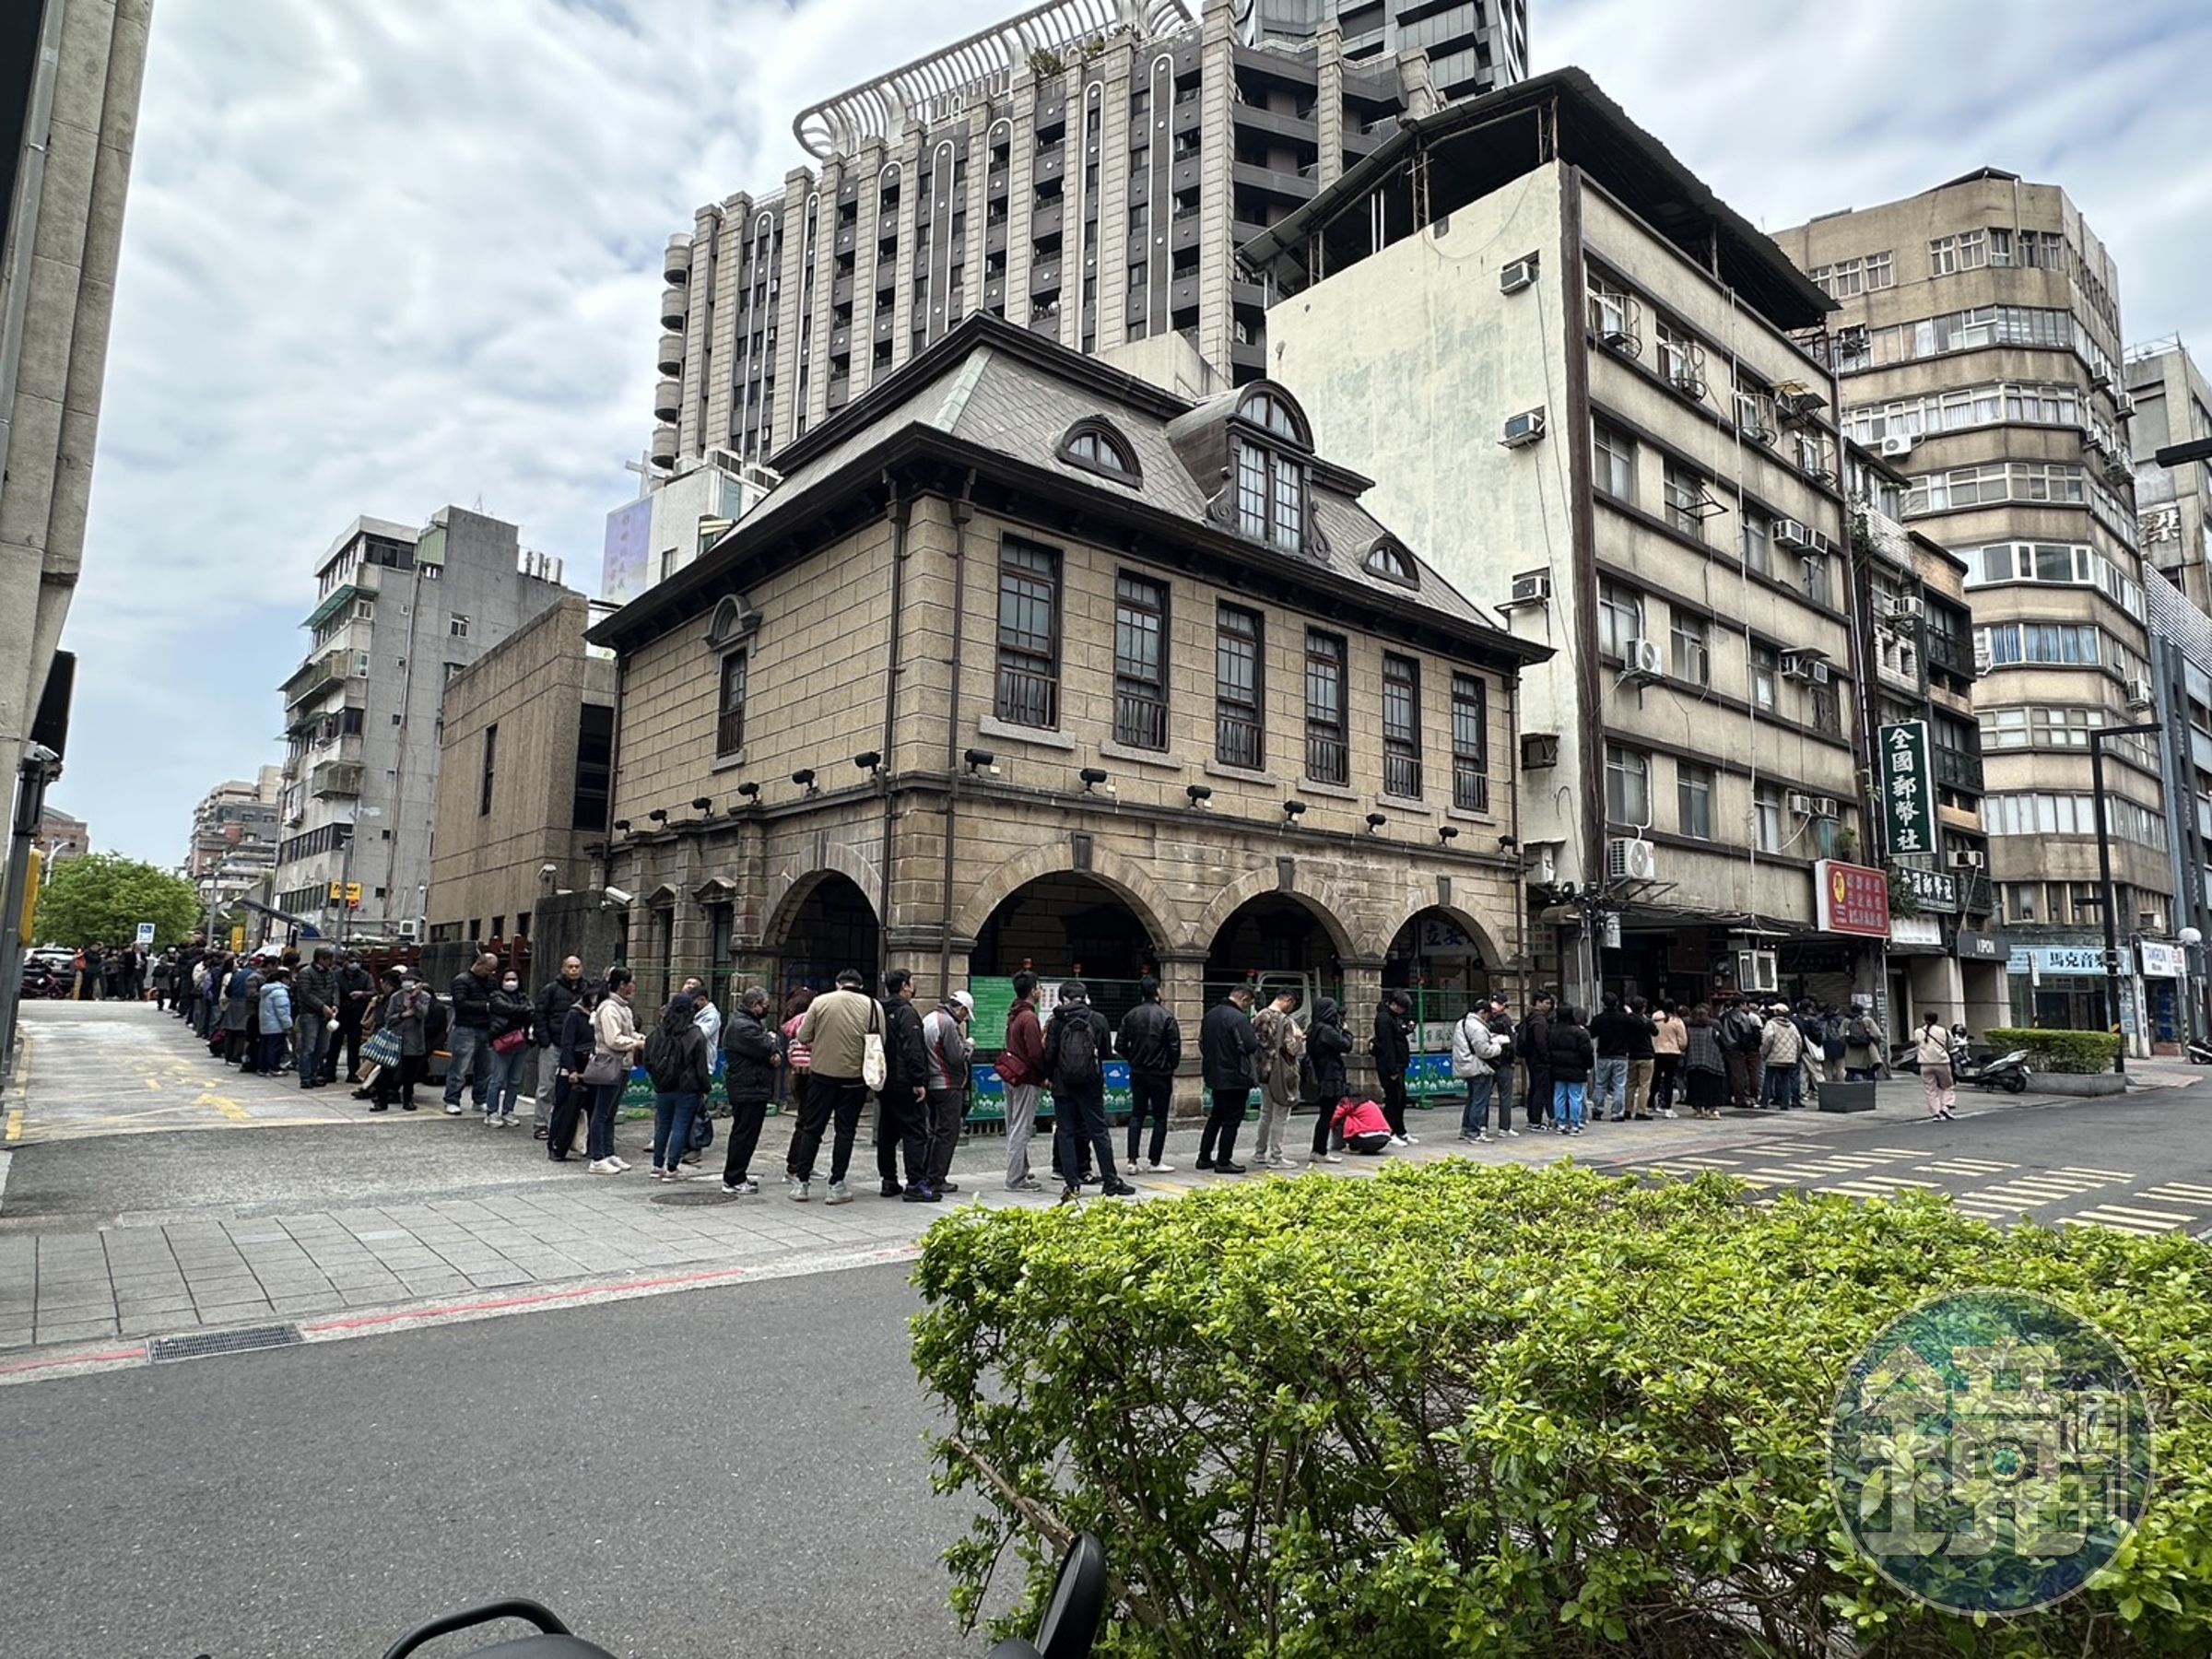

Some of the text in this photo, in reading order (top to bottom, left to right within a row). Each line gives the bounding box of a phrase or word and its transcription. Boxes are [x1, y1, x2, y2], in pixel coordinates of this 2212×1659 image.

[1888, 727, 1922, 852] 全國郵幣社
